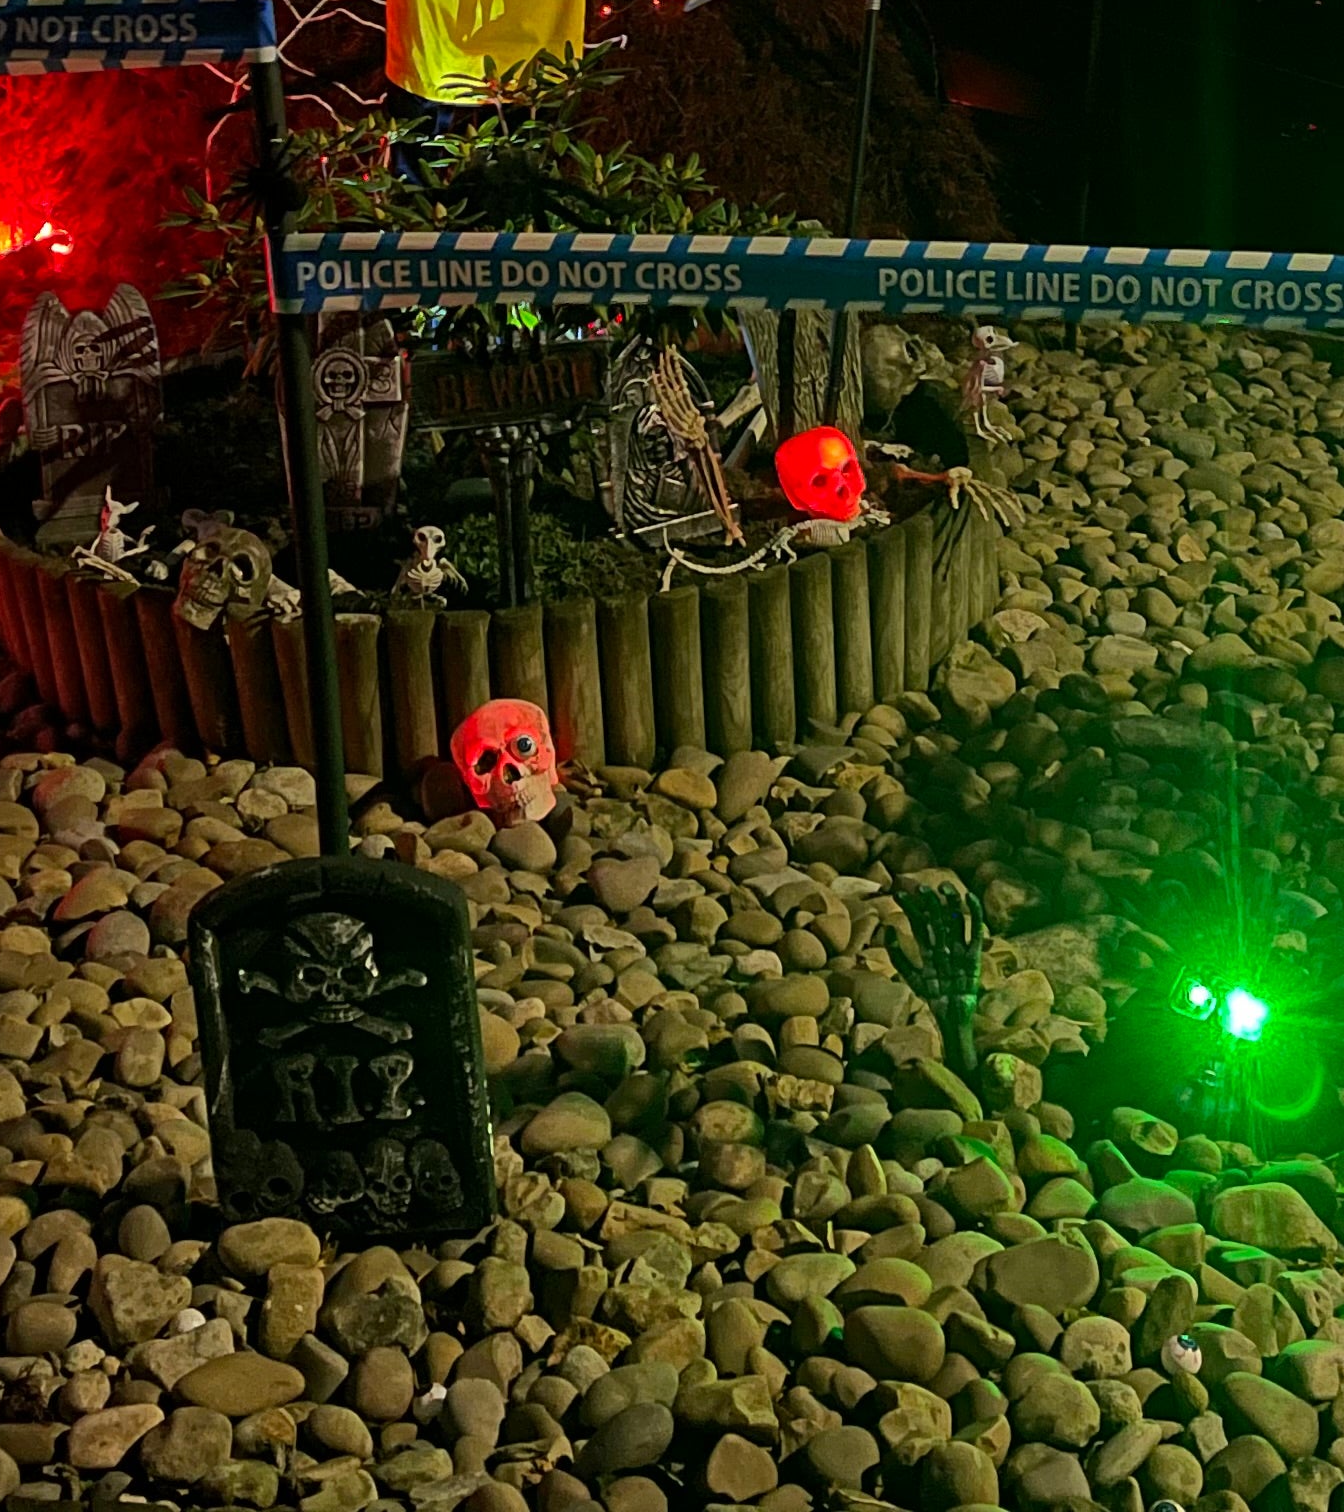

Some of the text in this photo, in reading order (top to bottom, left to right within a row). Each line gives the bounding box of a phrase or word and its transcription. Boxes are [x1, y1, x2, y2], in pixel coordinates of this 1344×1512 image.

[14, 15, 83, 42] NOT
[96, 13, 199, 44] CROSS
[297, 260, 743, 292] POLICE LINE DO NOT CROSS
[878, 267, 1344, 314] POLICE LINE DO NOT CROSS
